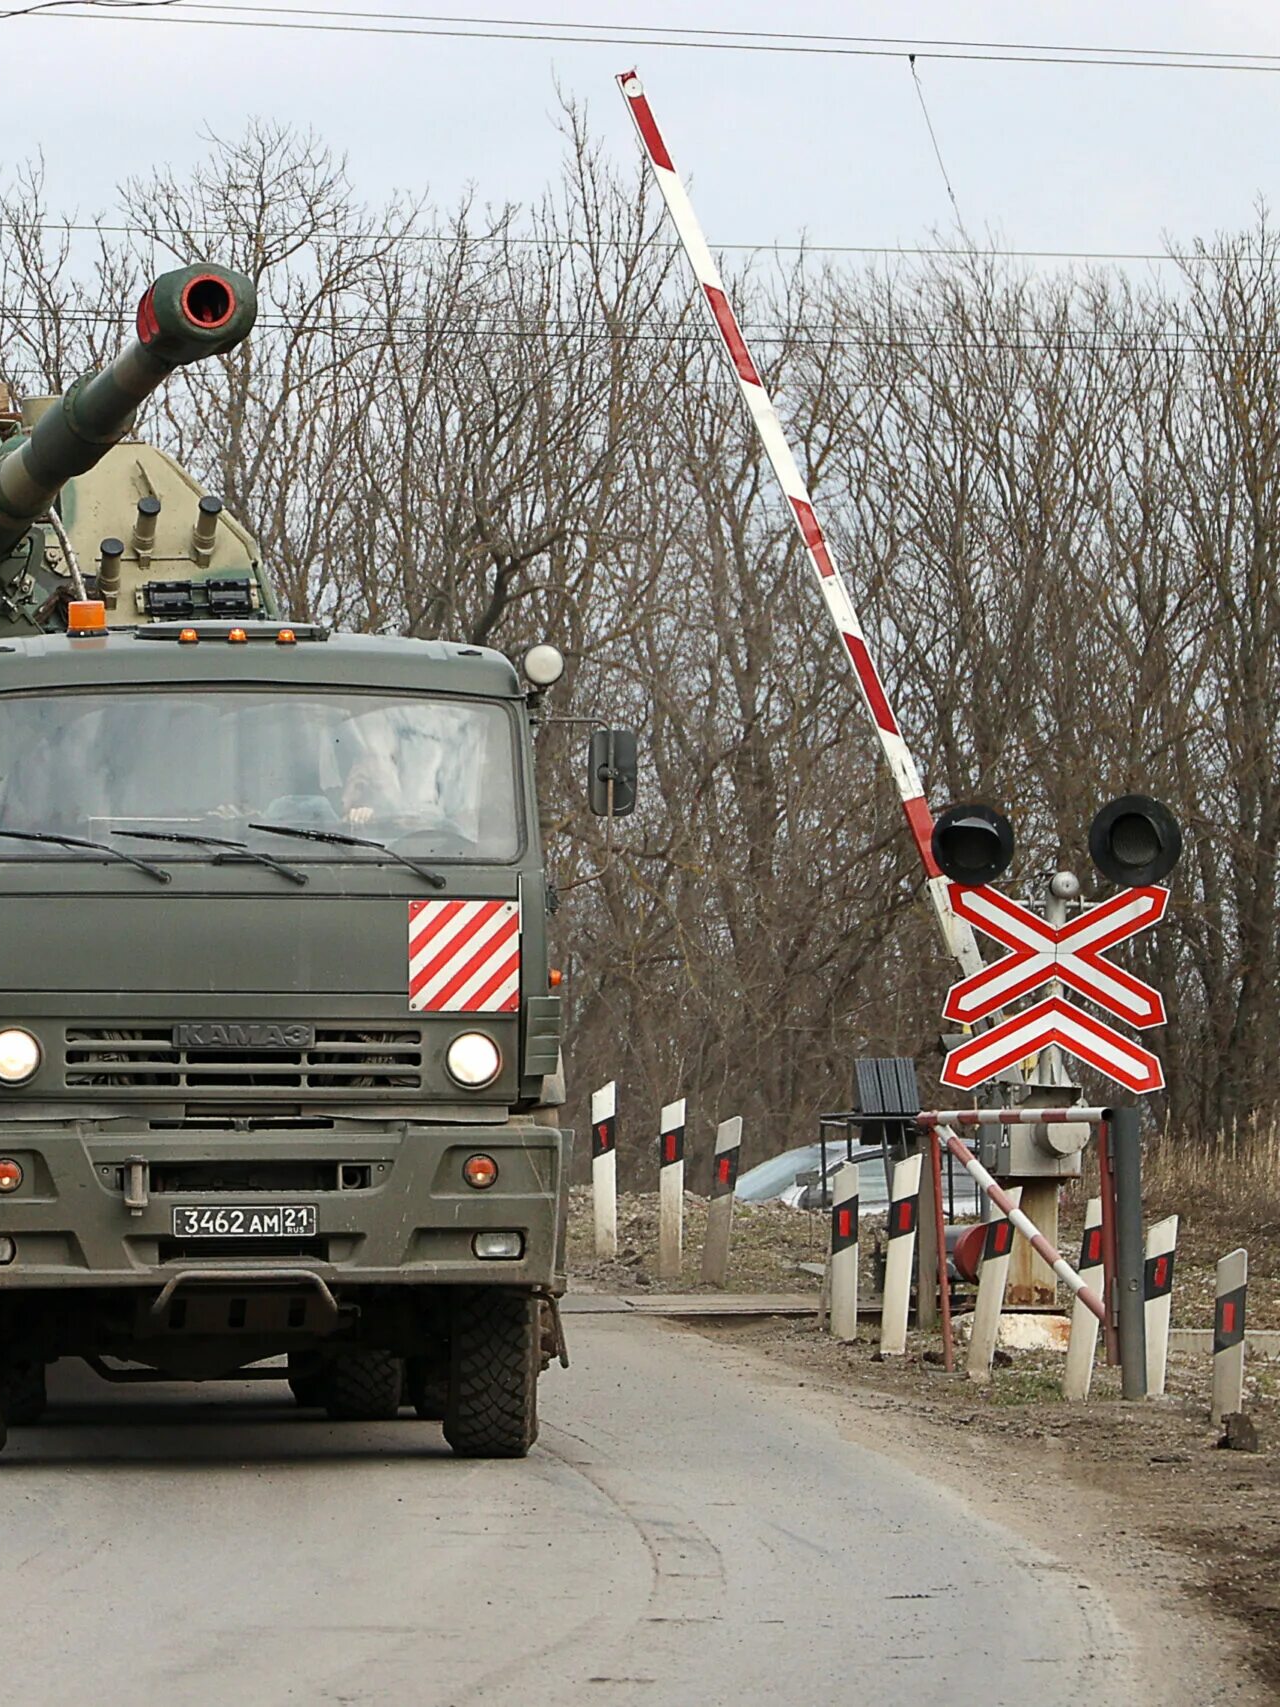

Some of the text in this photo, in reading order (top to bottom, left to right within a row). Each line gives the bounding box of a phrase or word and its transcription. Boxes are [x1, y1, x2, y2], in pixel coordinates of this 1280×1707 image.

[178, 1024, 311, 1047] КАМАЗ
[184, 1210, 244, 1233] 3462
[284, 1208, 307, 1227] 21
[287, 1226, 305, 1234] RUS
